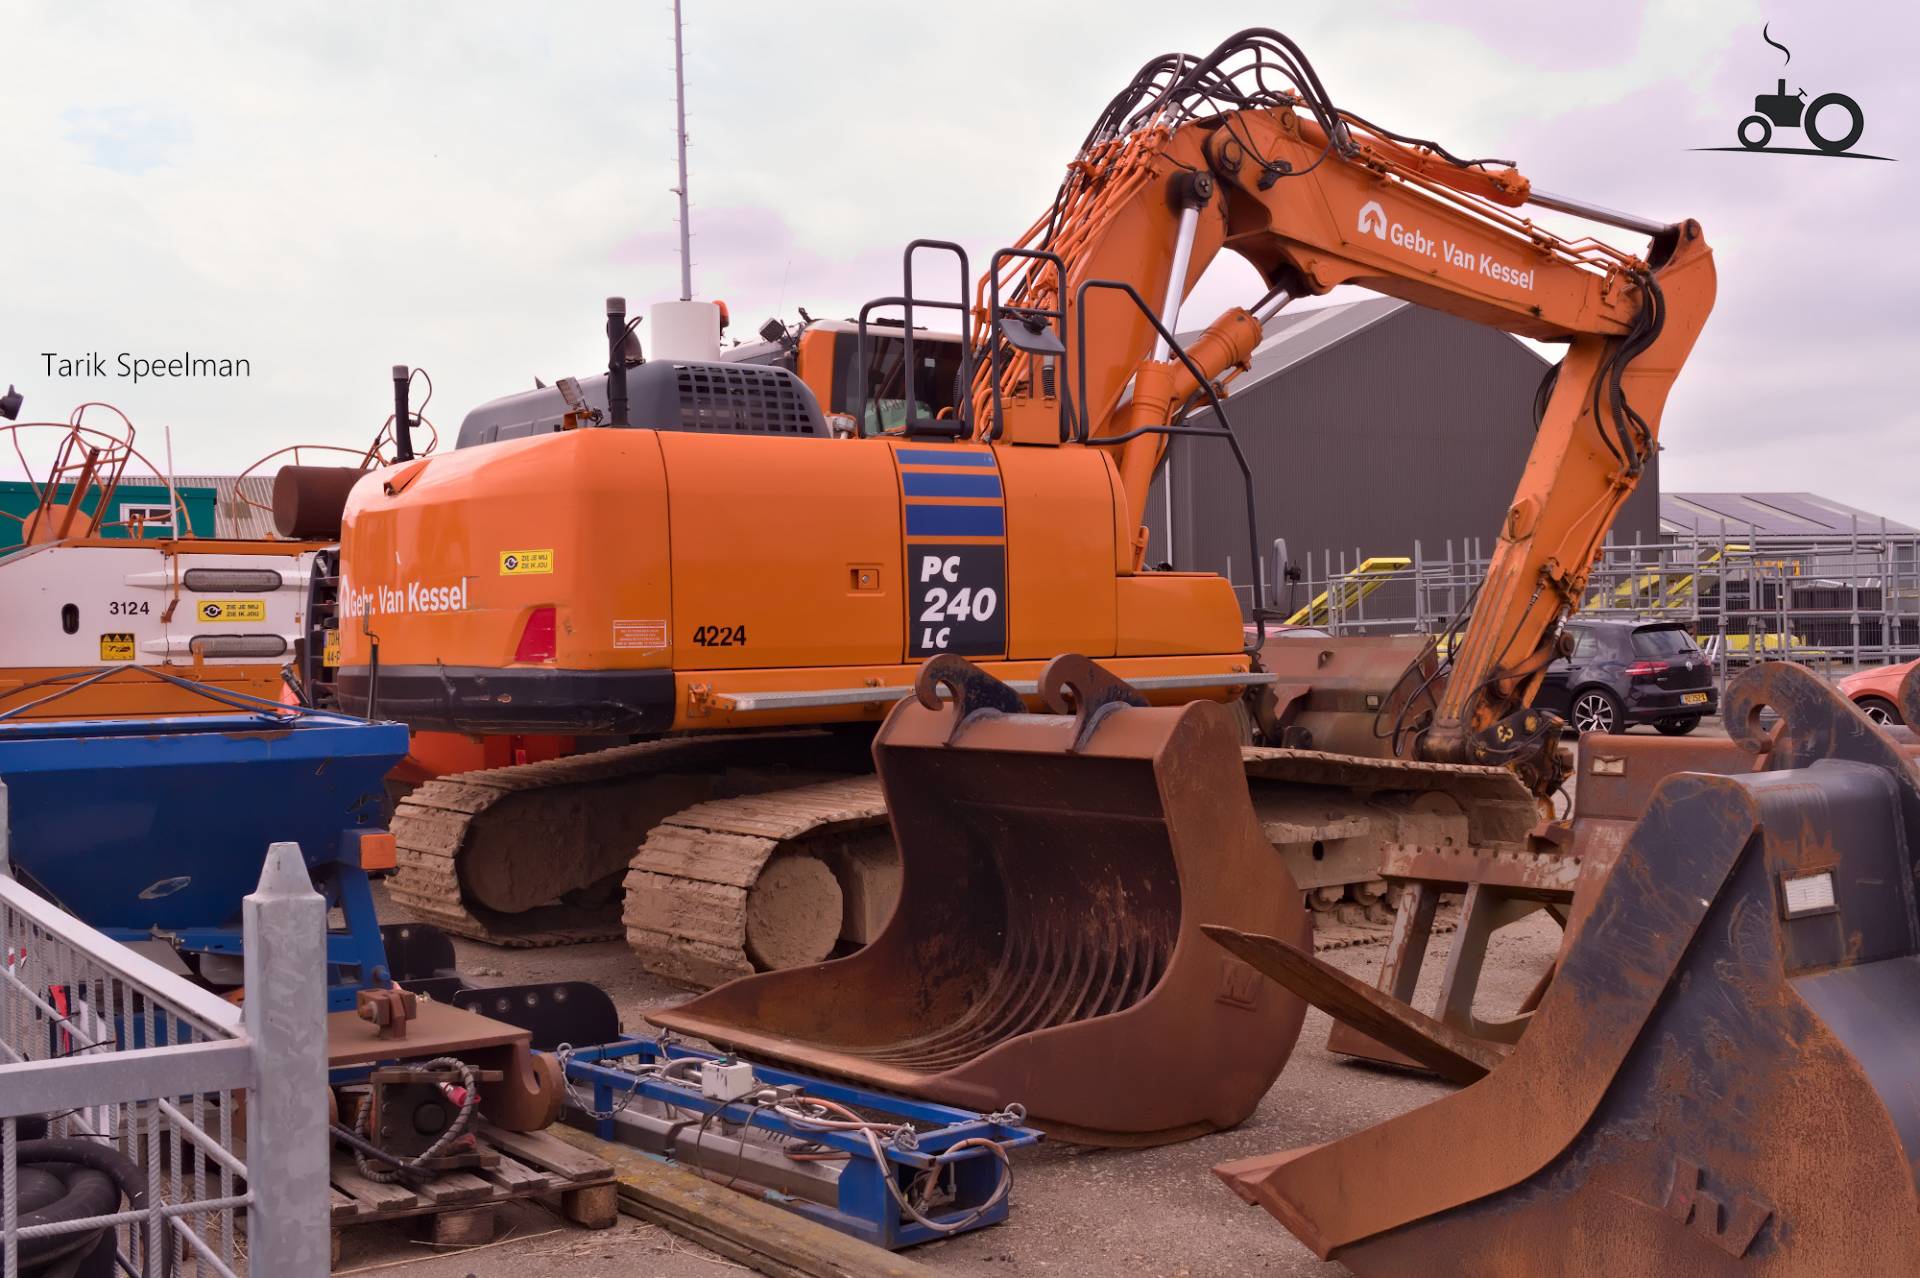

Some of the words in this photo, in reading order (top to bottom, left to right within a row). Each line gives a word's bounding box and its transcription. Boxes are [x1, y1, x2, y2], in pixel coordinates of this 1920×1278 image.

[1390, 223, 1437, 259] Gebr.
[1443, 240, 1475, 271] Van
[1479, 253, 1534, 291] Kessel
[920, 555, 961, 583] PC
[109, 601, 150, 616] 3124
[350, 586, 376, 617] Gebr.
[378, 584, 404, 614] Van
[408, 576, 468, 613] Kessel
[920, 587, 997, 622] 240
[693, 625, 747, 647] 4224
[921, 627, 951, 649] LC
